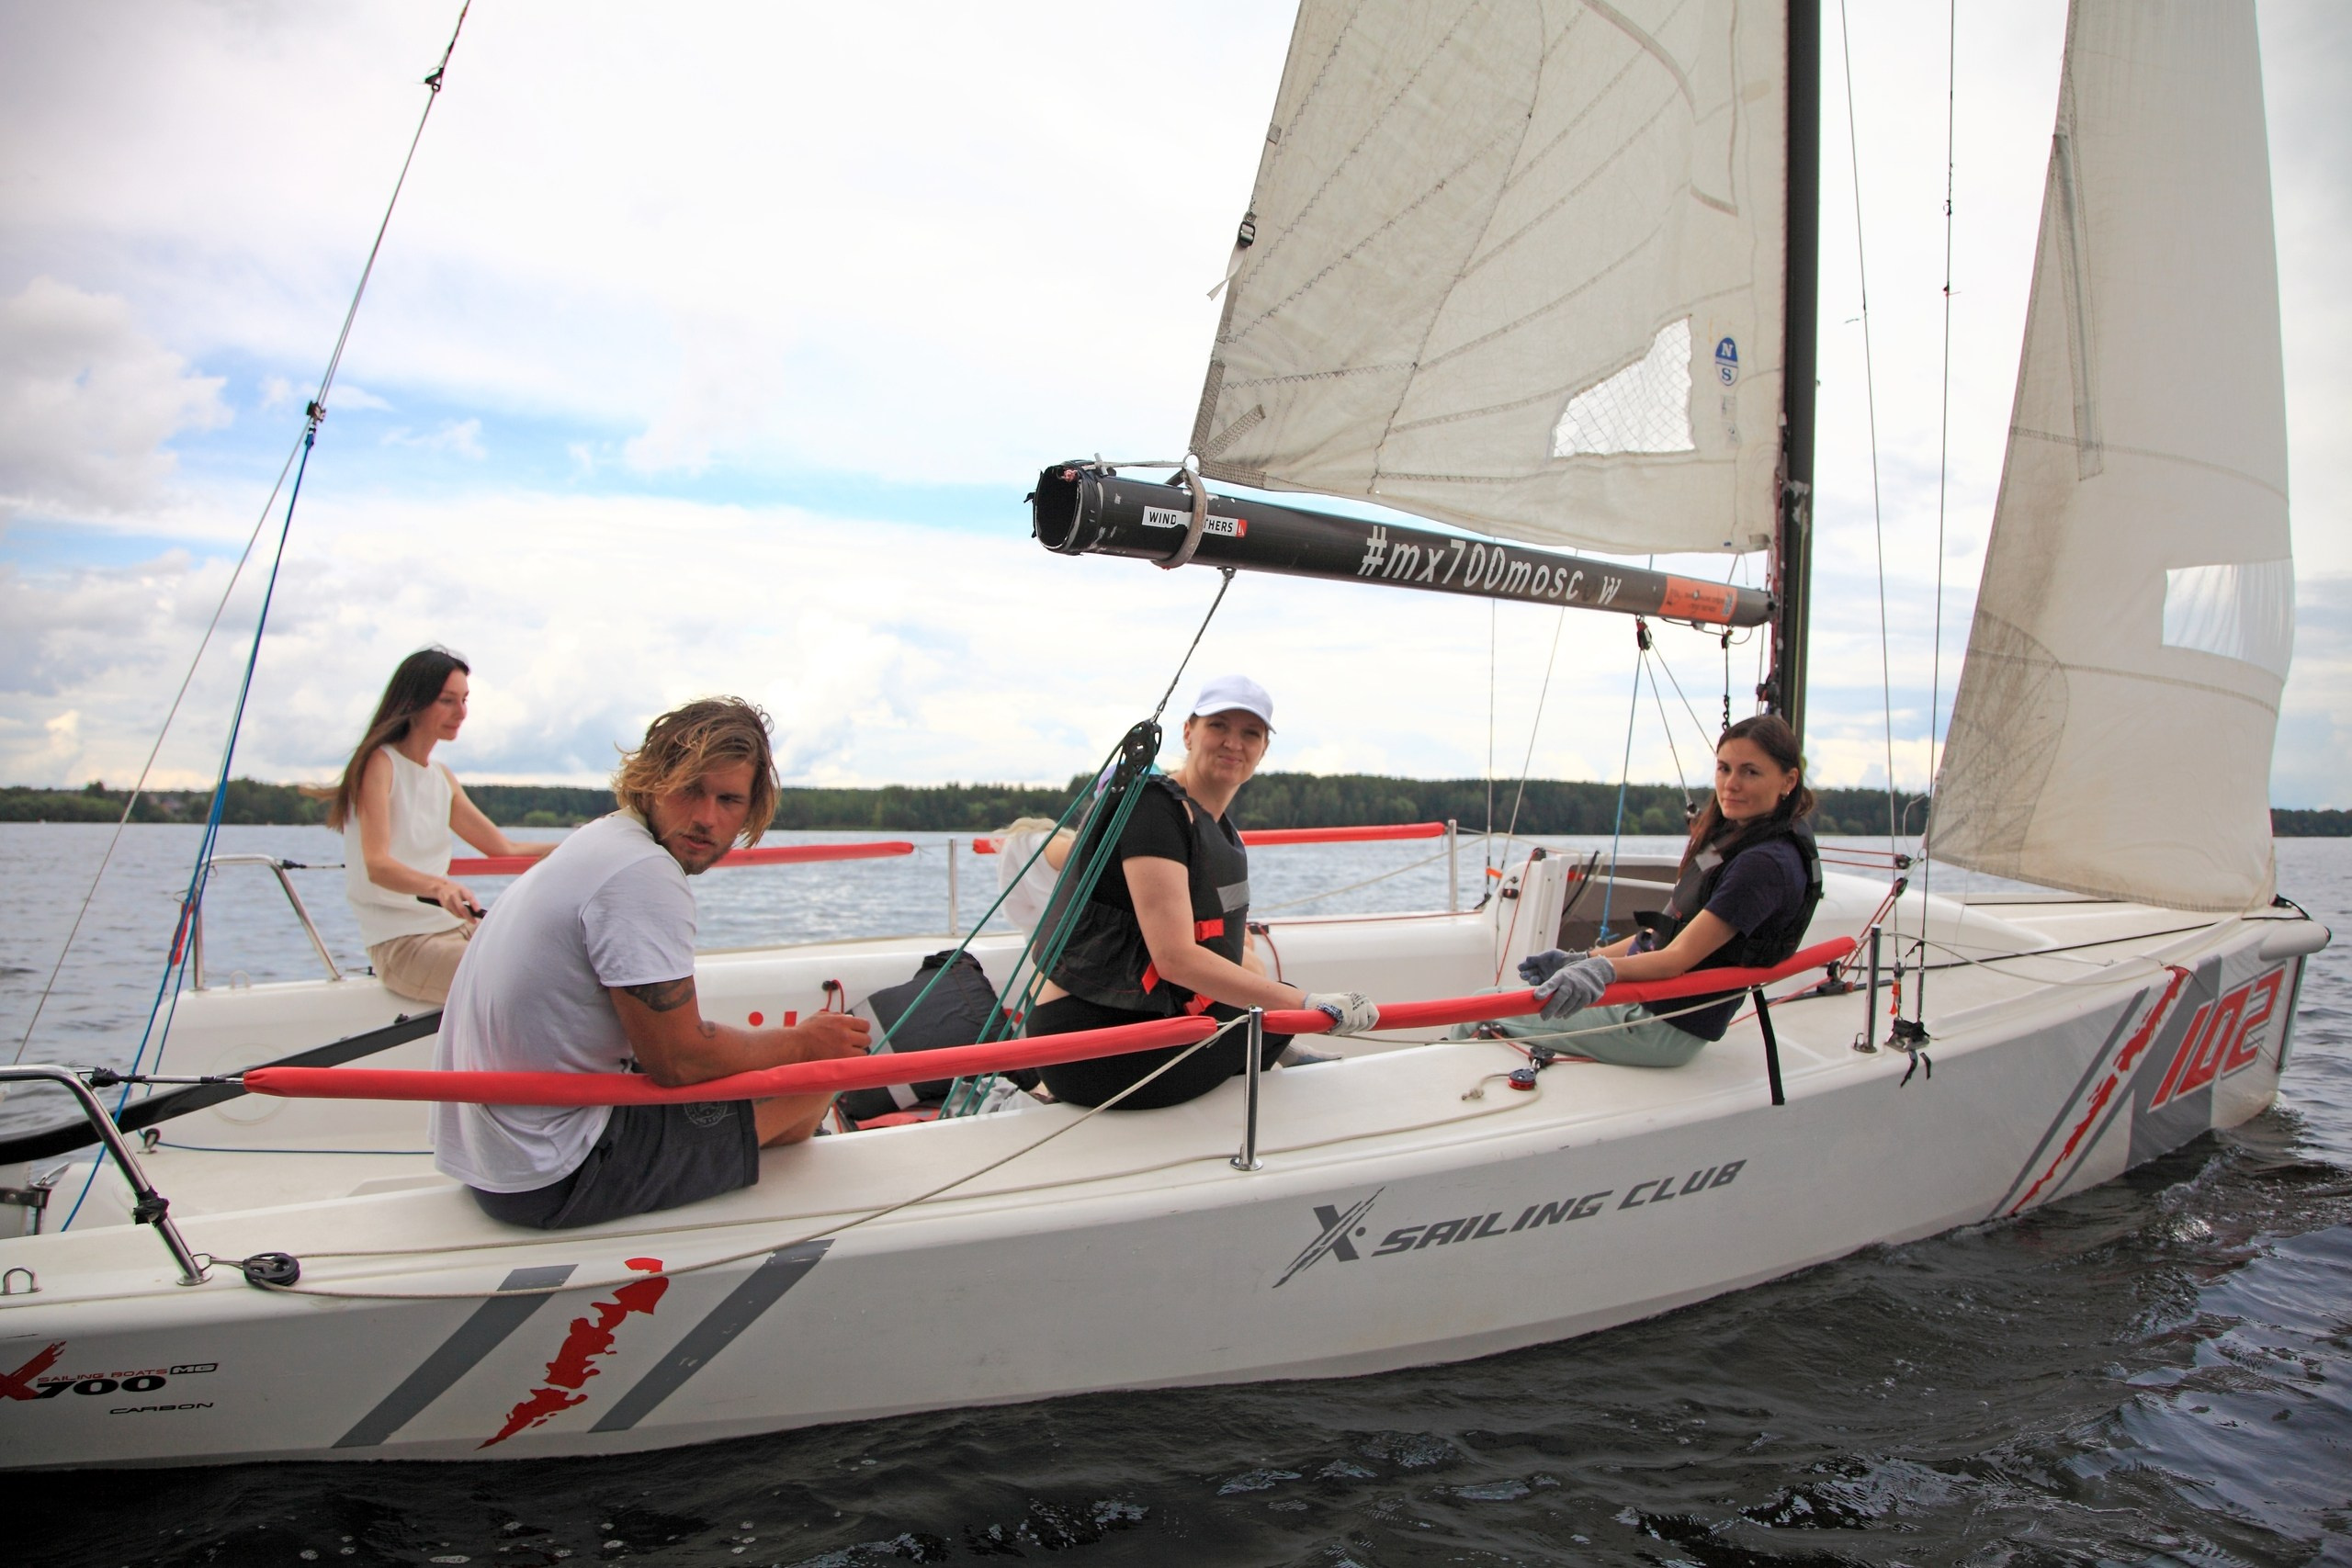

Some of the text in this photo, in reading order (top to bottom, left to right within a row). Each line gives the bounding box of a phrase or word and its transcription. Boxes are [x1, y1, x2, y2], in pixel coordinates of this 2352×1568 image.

[1721, 342, 1734, 357] N
[1722, 367, 1732, 381] S
[2147, 961, 2287, 1113] 102
[1371, 1190, 1613, 1257] SAILING
[1618, 1159, 1747, 1210] CLUB
[38, 1372, 104, 1382] SAILING
[111, 1369, 167, 1377] BOATS
[109, 1402, 214, 1415] CARBON
